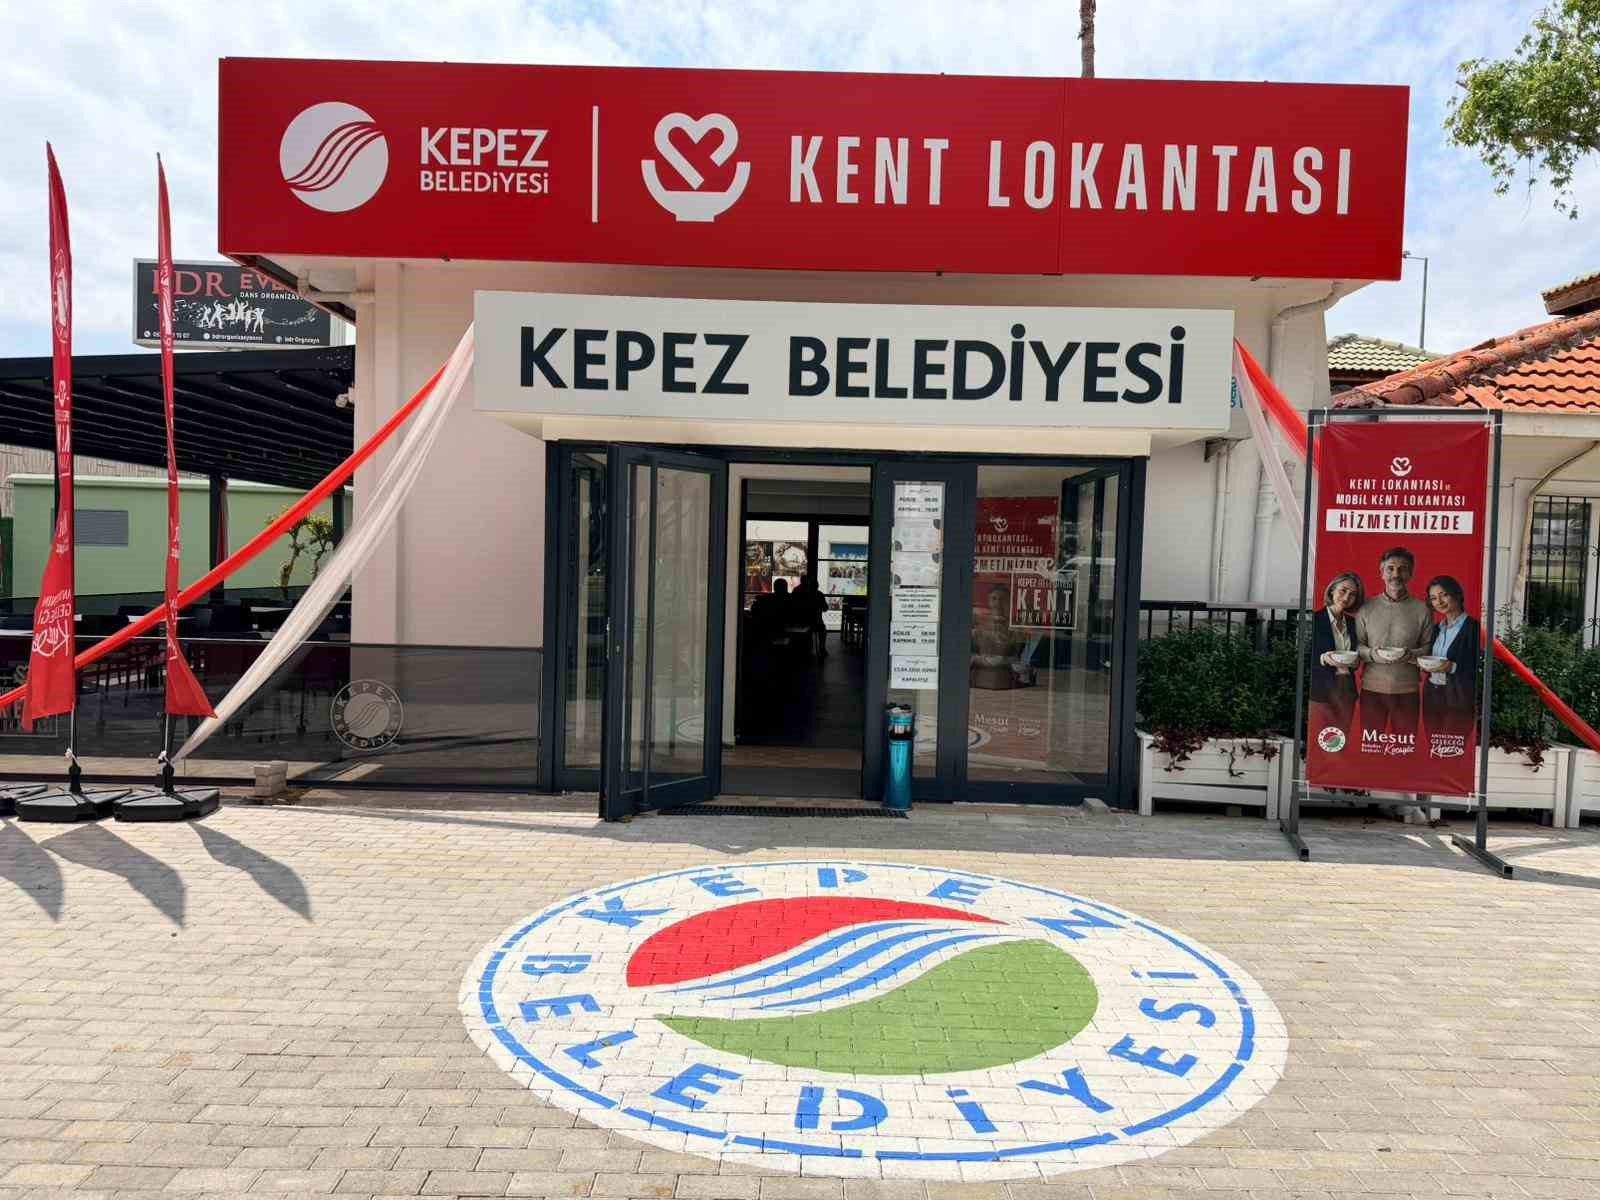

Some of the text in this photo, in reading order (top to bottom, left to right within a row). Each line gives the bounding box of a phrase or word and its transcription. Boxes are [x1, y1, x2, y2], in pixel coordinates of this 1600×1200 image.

[421, 127, 549, 167] KEPEZ
[790, 135, 1351, 214] KENT LOKANTASI
[520, 326, 750, 395] KEPEZ
[789, 323, 1186, 404] BELEDİYESİ
[1350, 479, 1376, 490] KENT
[1382, 480, 1443, 491] LOKANTASI
[1372, 495, 1398, 505] KENT
[1403, 496, 1465, 506] LOKANTASI
[1339, 511, 1460, 530] HİZMETİNİZDE
[1017, 589, 1073, 611] KENT
[1361, 728, 1415, 745] Mesut
